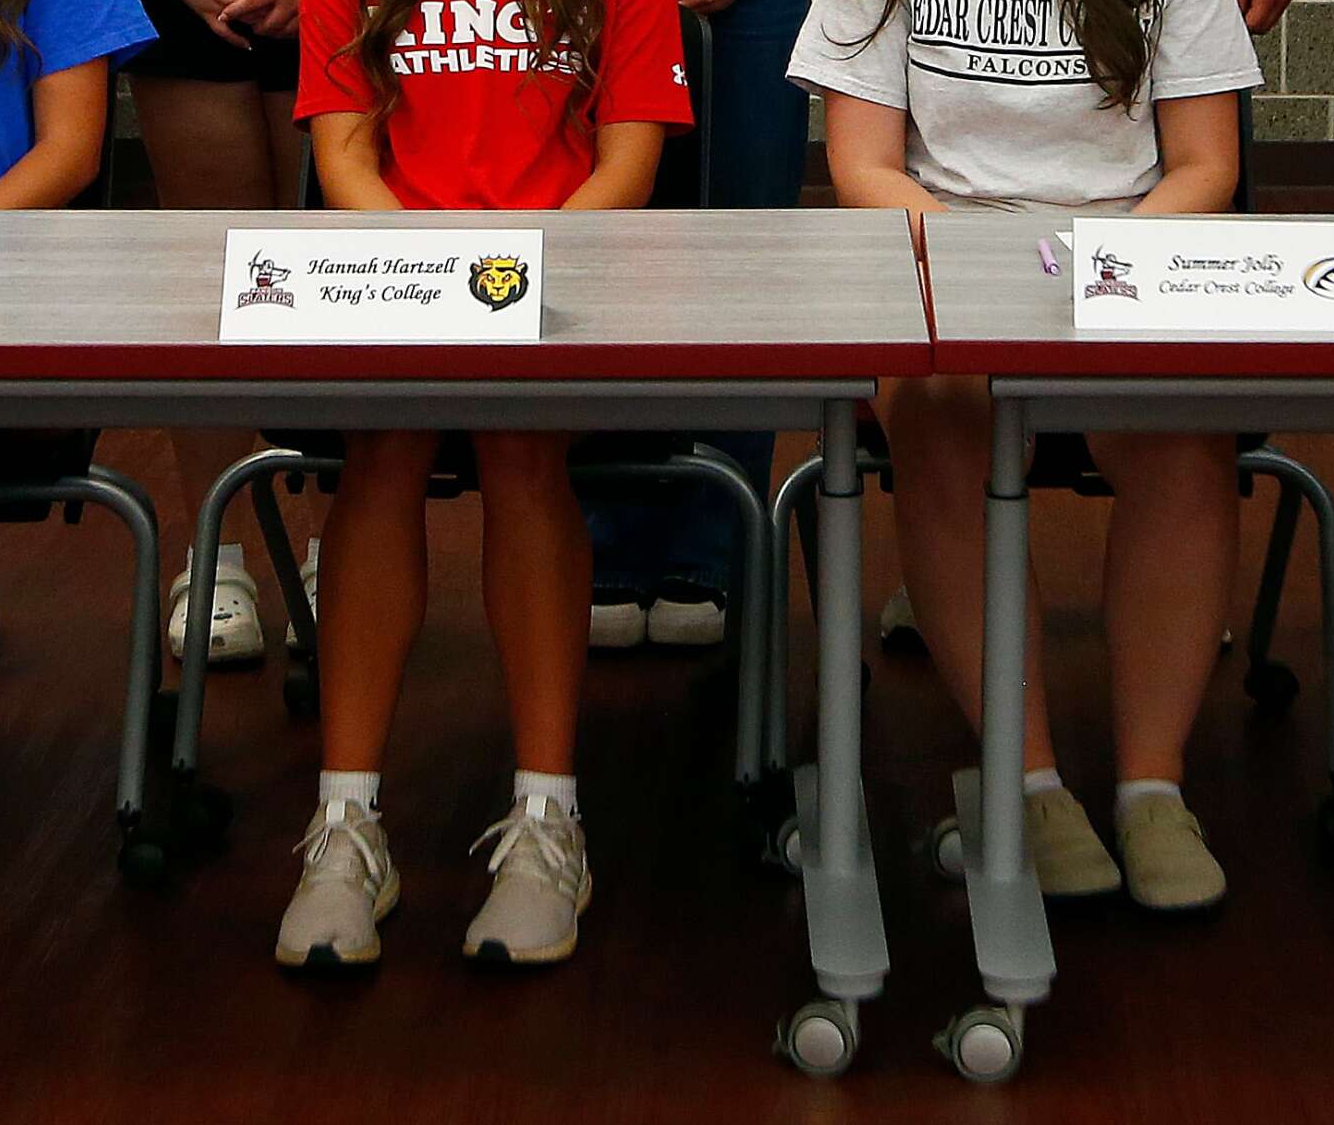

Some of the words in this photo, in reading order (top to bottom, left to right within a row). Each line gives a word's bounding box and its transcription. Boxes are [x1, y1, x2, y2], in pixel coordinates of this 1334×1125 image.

[967, 54, 1086, 76] FALCONS
[307, 258, 379, 275] Hannah
[382, 257, 459, 275] Hartzell
[1168, 255, 1237, 271] Summer
[1241, 255, 1284, 276] Jolly
[319, 284, 375, 305] King's
[381, 284, 441, 306] College
[1159, 279, 1199, 294] Cedar
[1204, 280, 1240, 295] Crest
[1245, 280, 1295, 298] College
